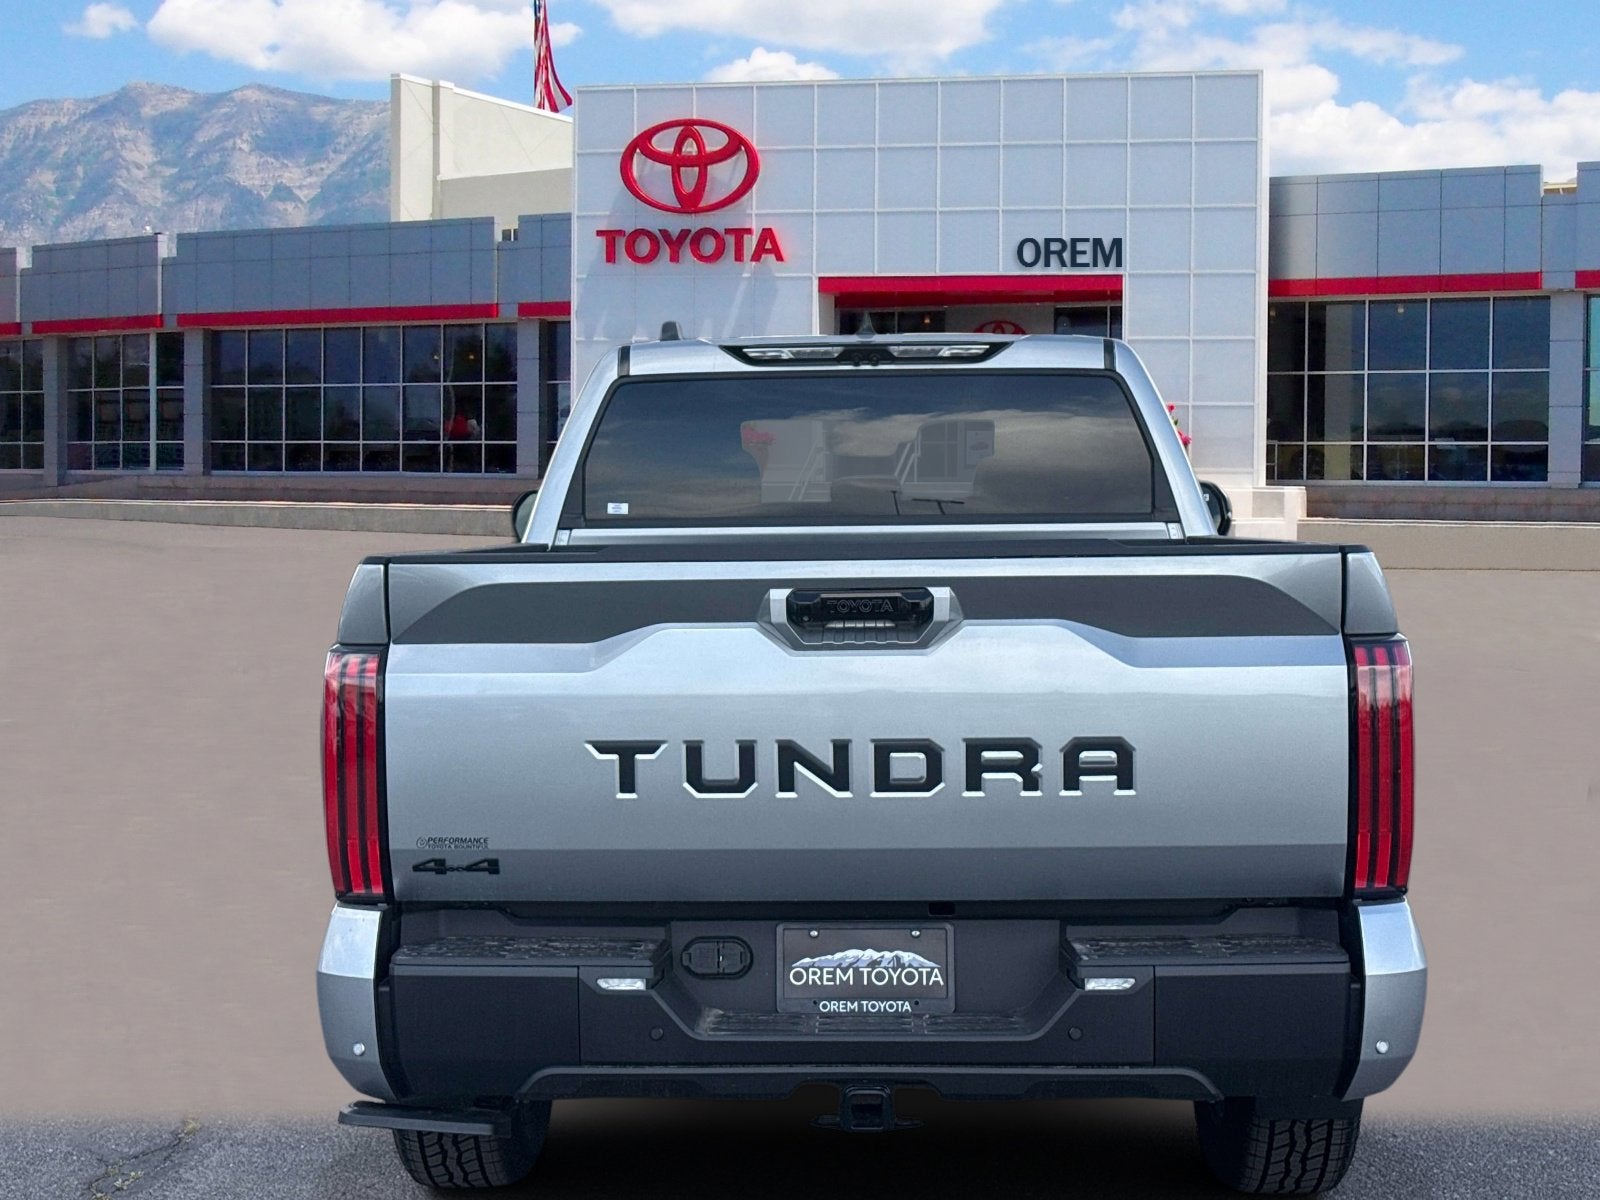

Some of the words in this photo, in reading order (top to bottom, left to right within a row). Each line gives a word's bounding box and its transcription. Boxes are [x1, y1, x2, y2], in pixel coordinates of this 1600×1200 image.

[596, 227, 785, 265] TOYOTA
[1016, 237, 1123, 268] OREM
[826, 599, 894, 613] TOYOTA
[584, 736, 1137, 799] TUNDRA
[427, 836, 489, 844] PERFORMANCE
[789, 967, 854, 986] OREM
[858, 967, 945, 986] TOYOTA
[819, 1001, 858, 1013] OREM
[860, 1001, 912, 1013] TOYOTA
